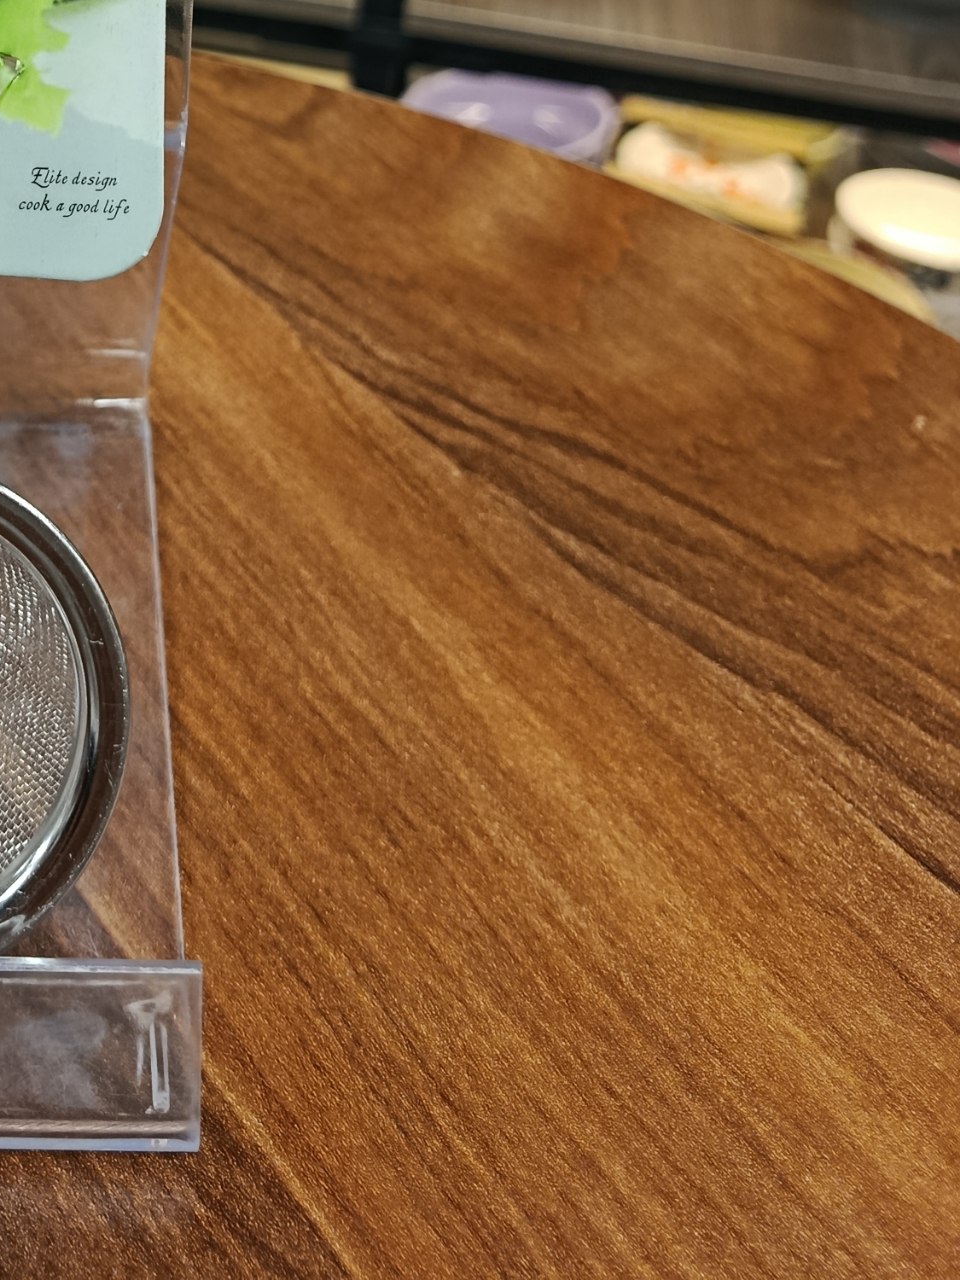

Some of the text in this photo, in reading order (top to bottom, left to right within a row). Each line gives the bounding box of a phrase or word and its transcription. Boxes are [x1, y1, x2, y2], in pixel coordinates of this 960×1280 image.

[30, 166, 118, 192] Elite design
[18, 193, 131, 221] cook a good life
